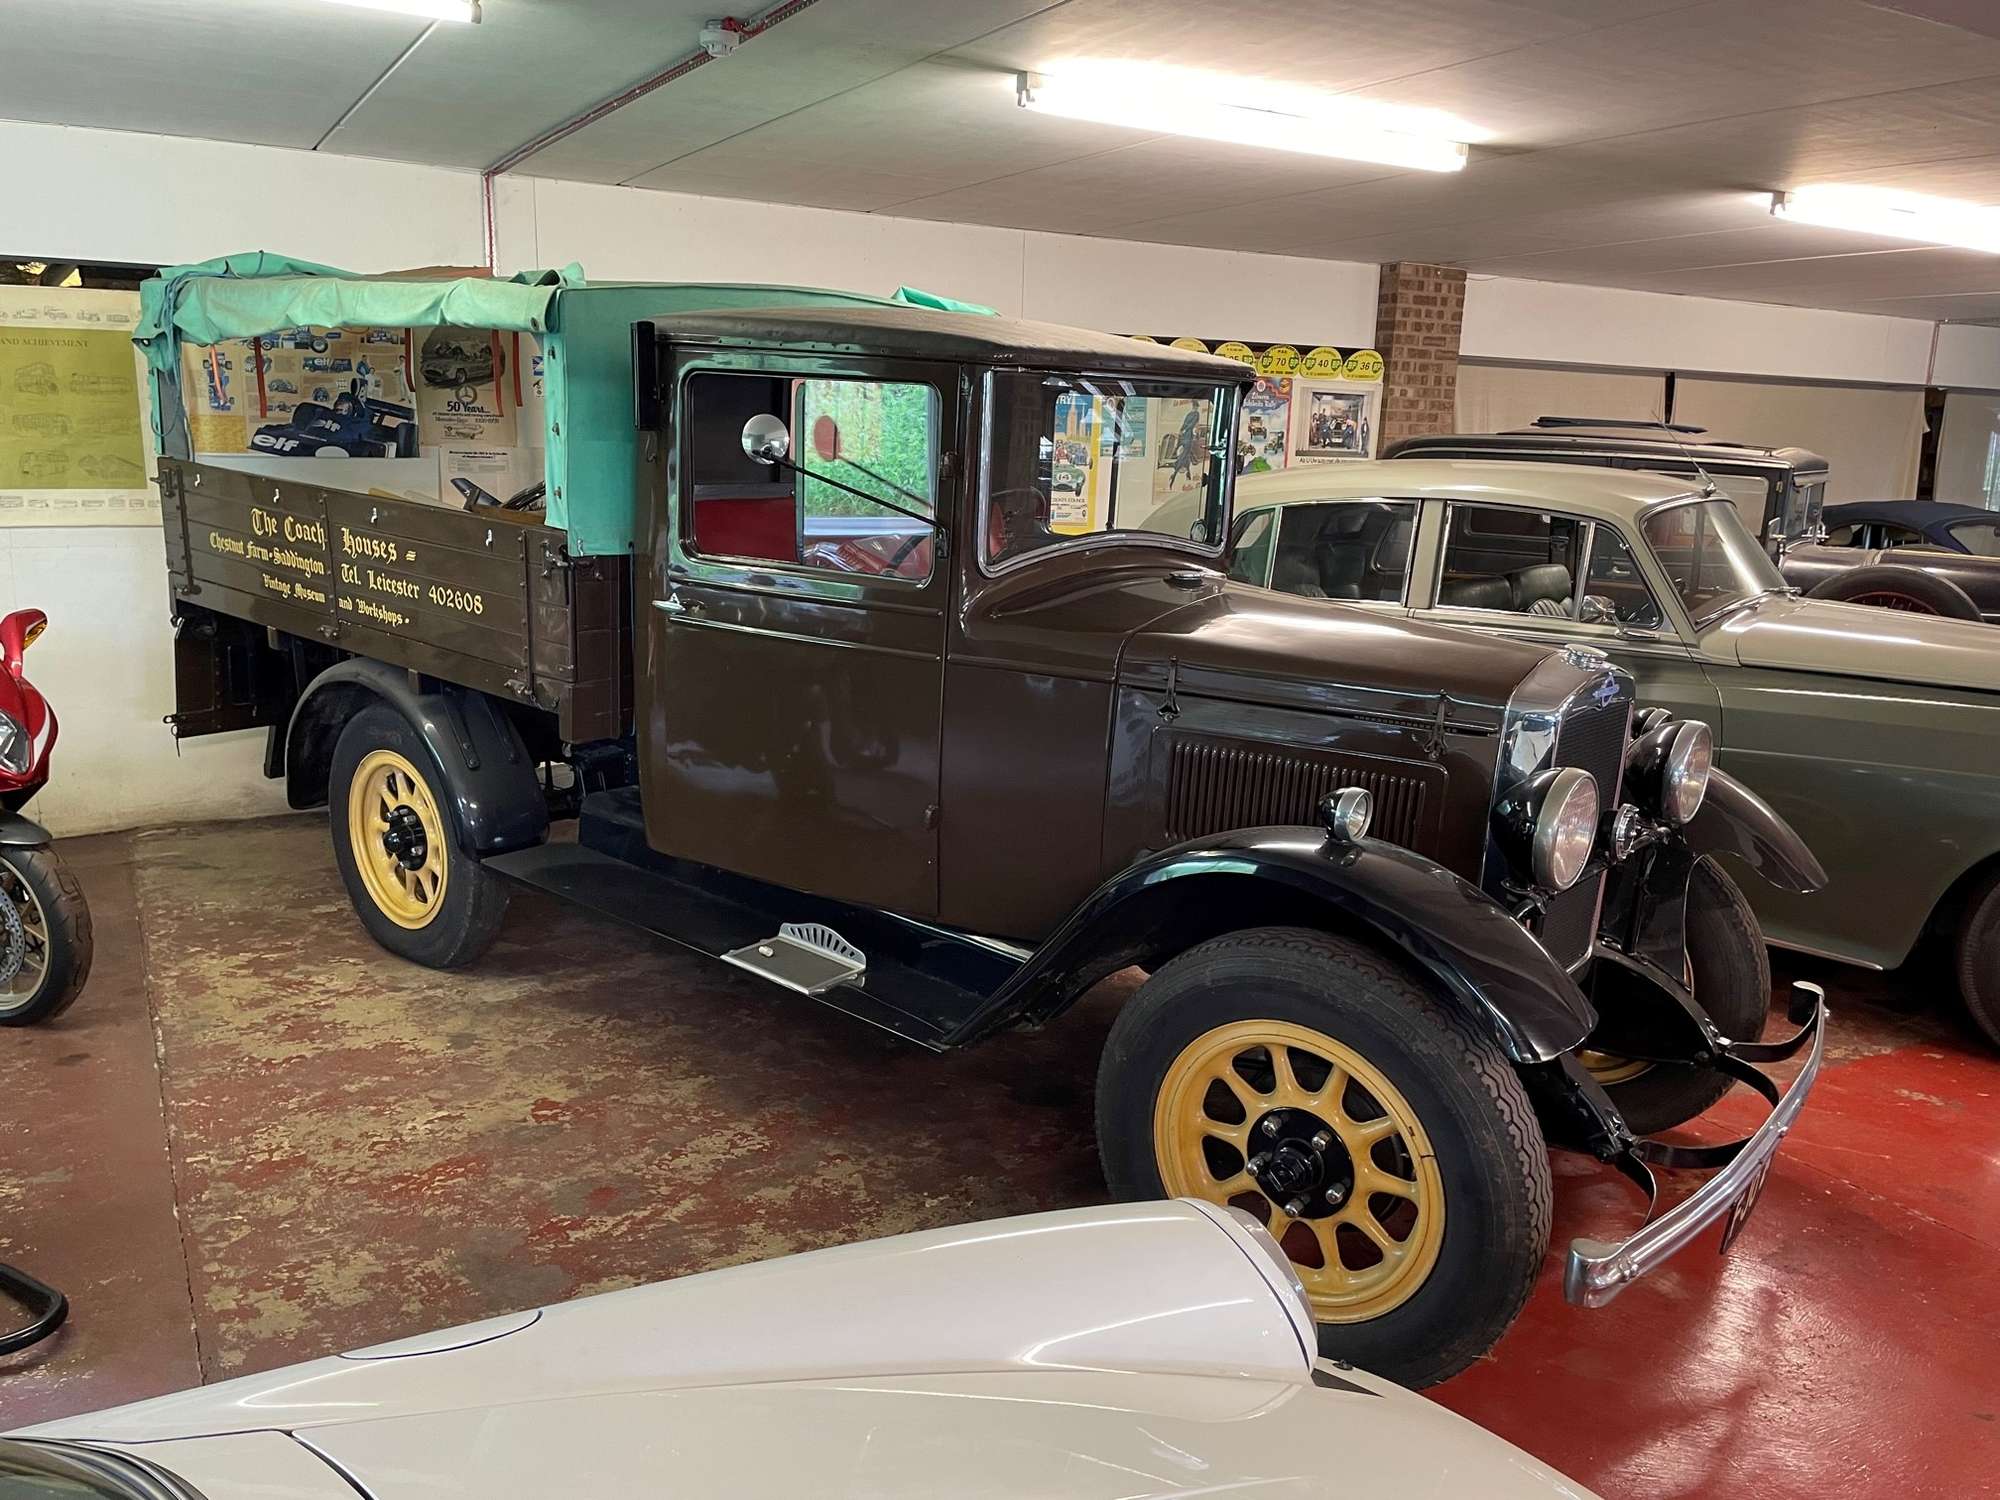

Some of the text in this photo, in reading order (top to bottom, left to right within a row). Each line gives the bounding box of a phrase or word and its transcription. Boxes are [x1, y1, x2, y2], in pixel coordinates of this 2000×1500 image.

[23, 338, 88, 348] ACHIEVEMENT
[1276, 357, 1287, 367] 70
[1317, 359, 1329, 367] 40
[1360, 362, 1370, 370] 36
[447, 401, 460, 413] 50
[252, 434, 299, 451] elf
[251, 508, 397, 564] The Coach Houses
[209, 532, 244, 552] Chestnut
[341, 563, 362, 585] Tel.
[367, 570, 420, 599] Leicester
[428, 585, 484, 615] 402608
[262, 573, 291, 598] Vintage
[294, 583, 325, 603] Museum
[338, 596, 353, 611] and
